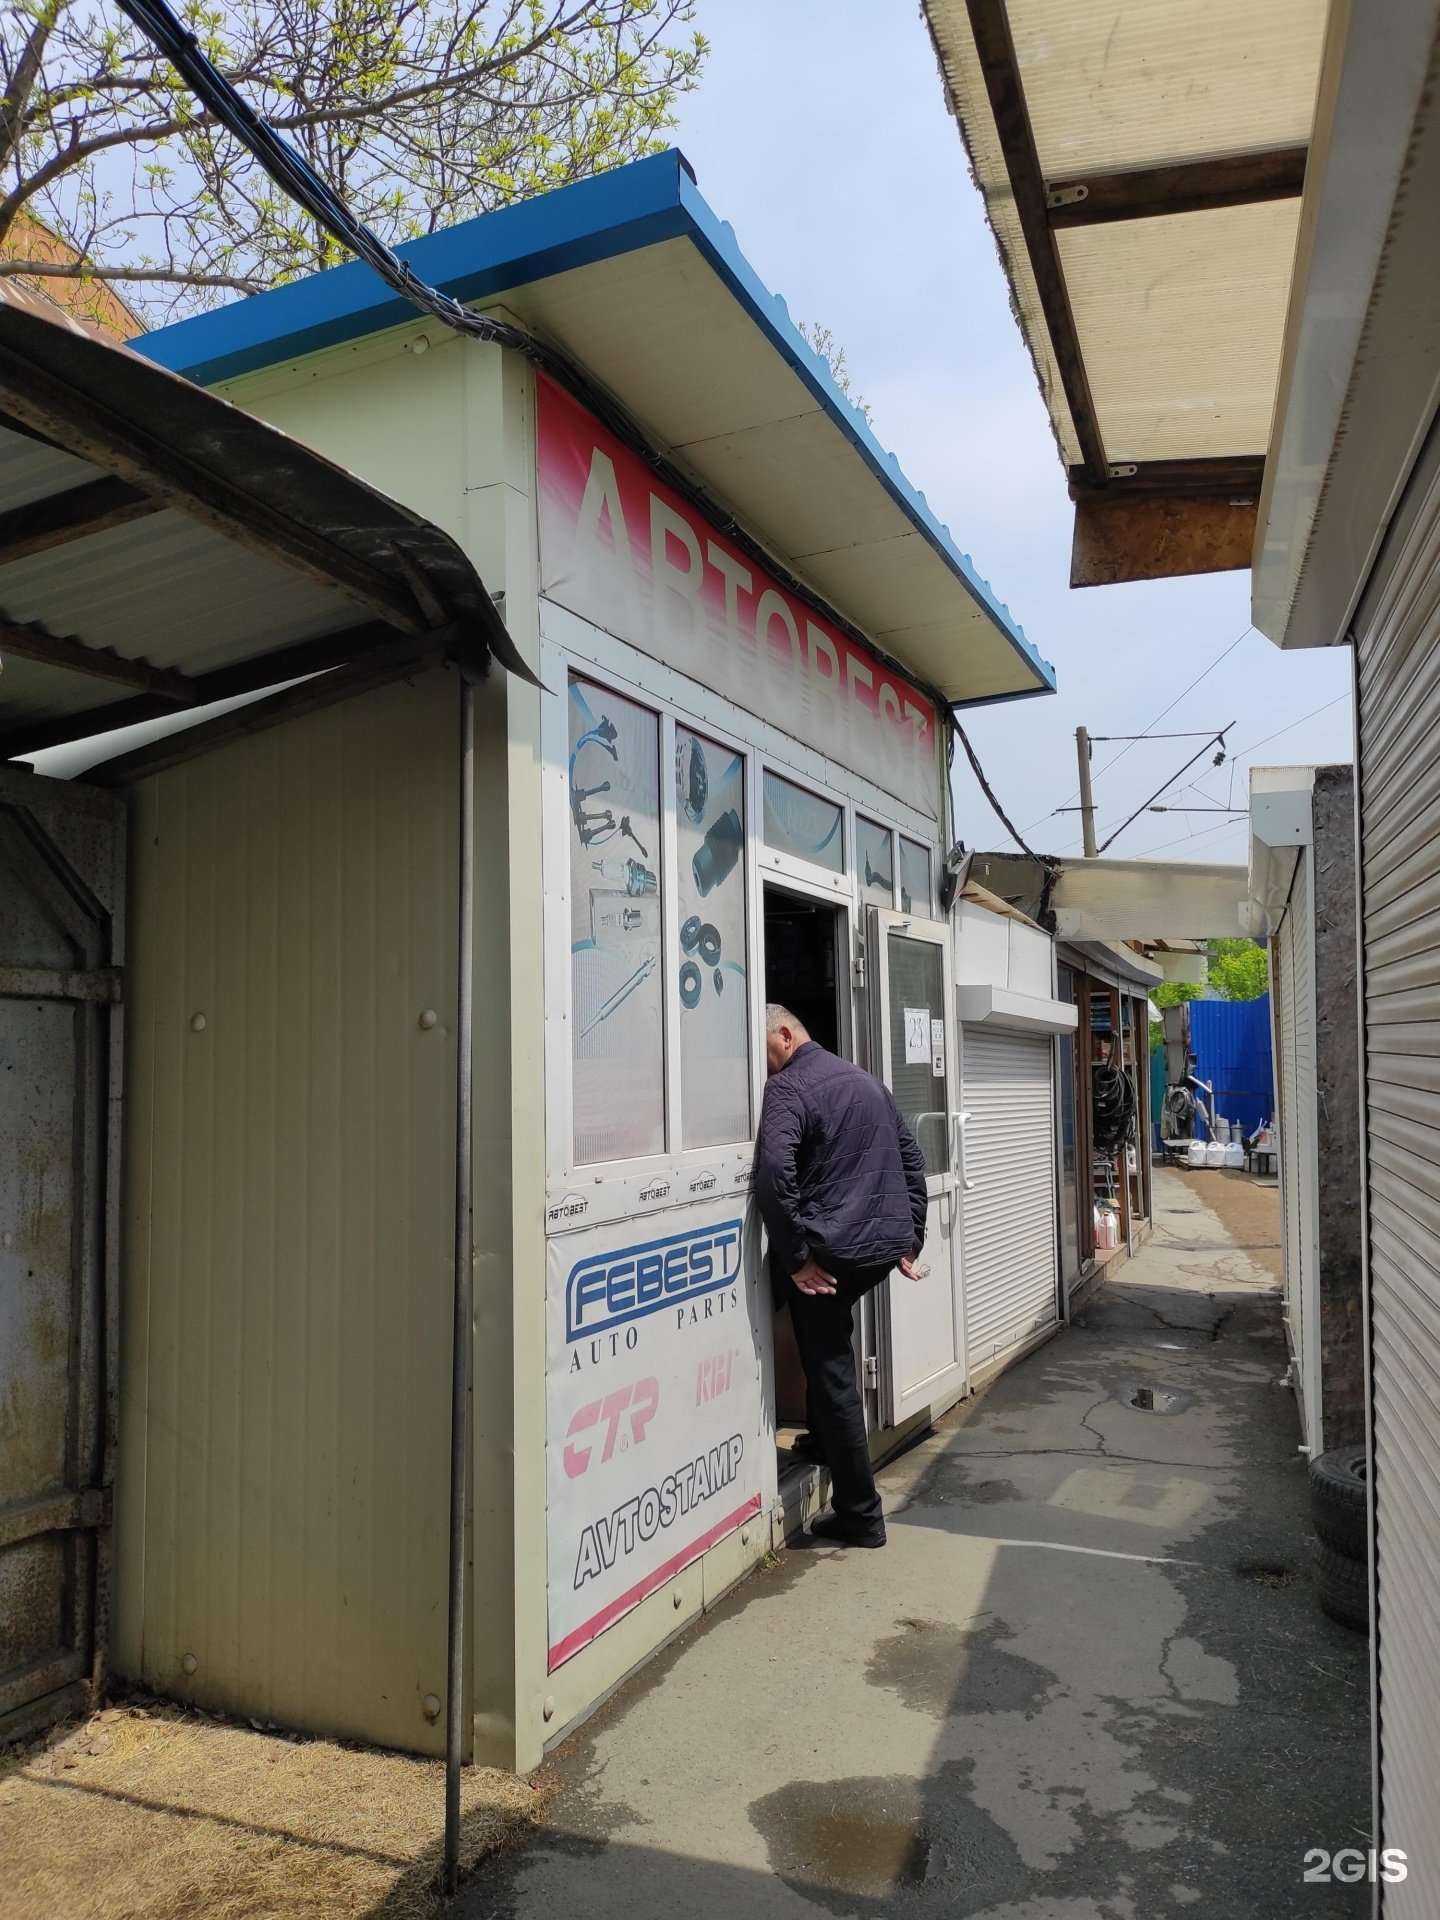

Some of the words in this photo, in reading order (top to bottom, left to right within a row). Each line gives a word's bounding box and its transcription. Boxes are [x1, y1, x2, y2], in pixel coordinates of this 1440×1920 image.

[575, 1232, 737, 1326] FEBEST
[570, 1326, 639, 1373] AUTO
[676, 1288, 738, 1329] PARTS
[563, 1376, 660, 1479] CTR
[573, 1433, 744, 1591] AVTOSTAMP
